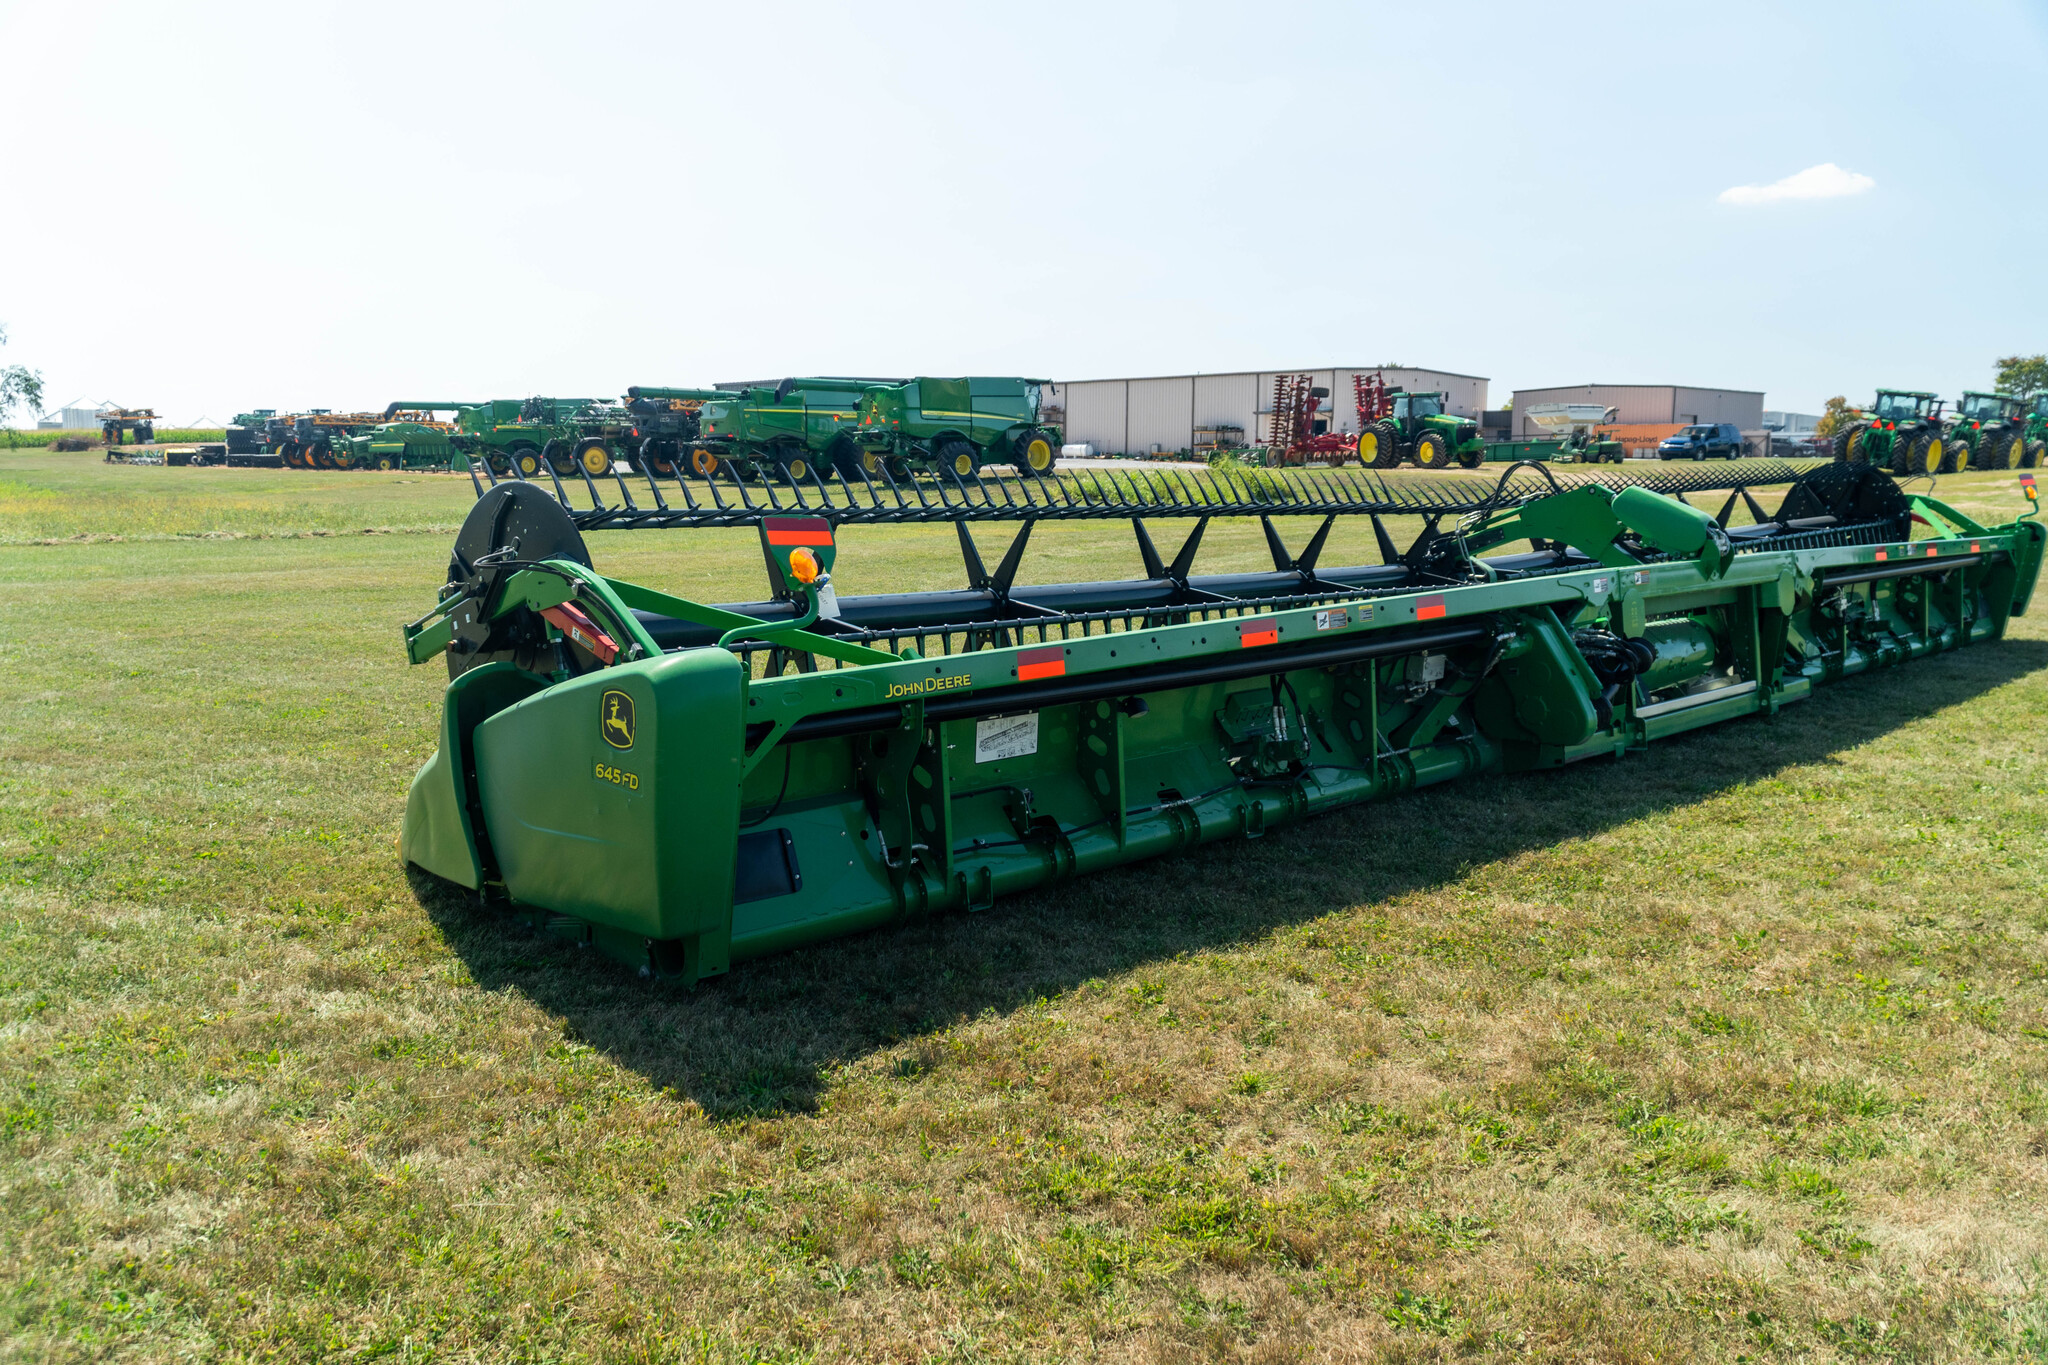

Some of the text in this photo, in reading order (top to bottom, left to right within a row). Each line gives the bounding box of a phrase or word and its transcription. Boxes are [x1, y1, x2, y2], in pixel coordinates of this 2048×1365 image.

[1615, 435, 1658, 444] Hapag-Lloyd
[885, 674, 972, 698] JOHN DEERE
